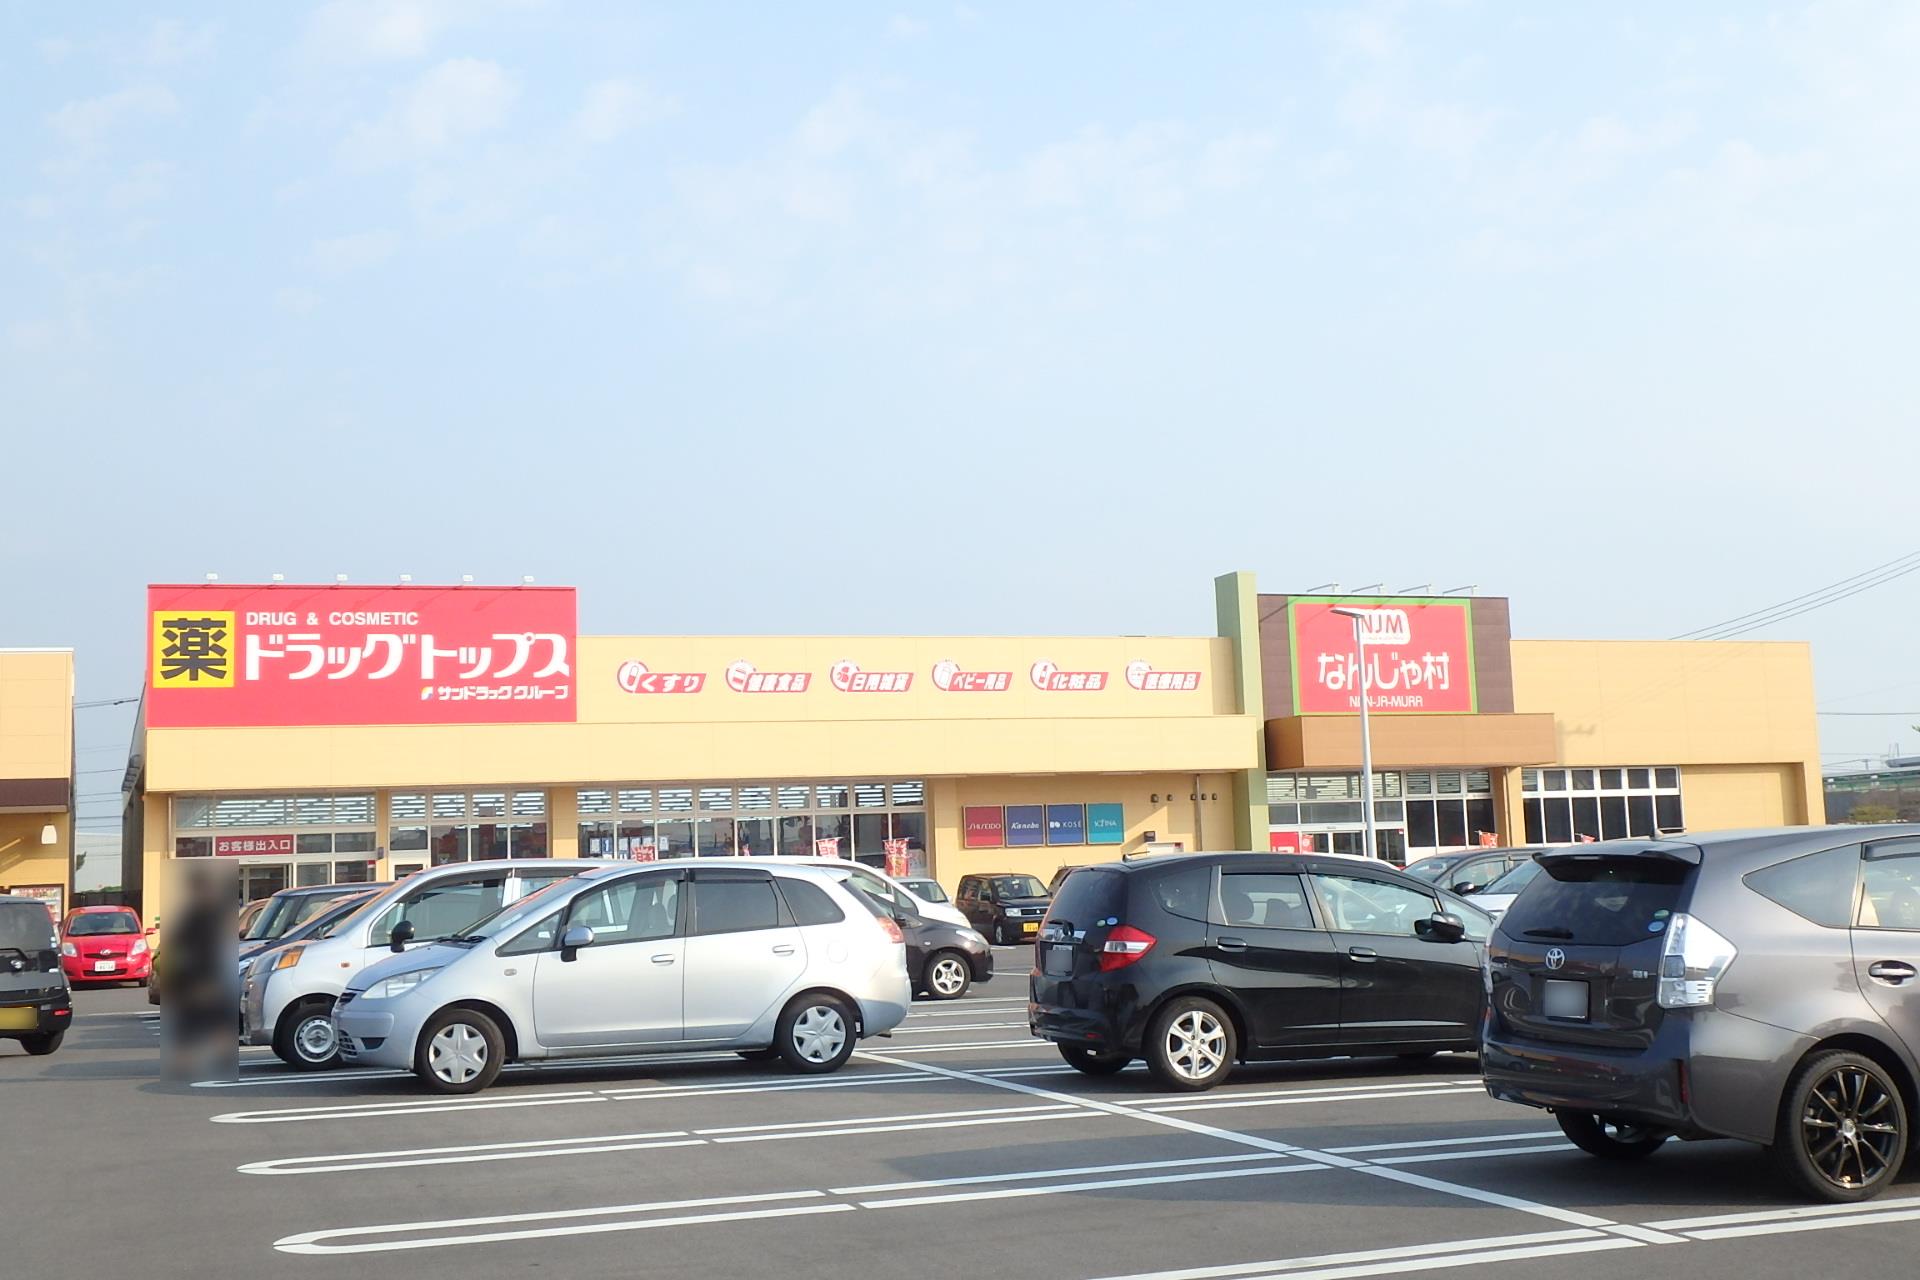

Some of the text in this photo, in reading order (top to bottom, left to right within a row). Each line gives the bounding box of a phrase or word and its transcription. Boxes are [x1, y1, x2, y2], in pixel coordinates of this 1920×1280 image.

[246, 611, 419, 626] DRUG & COSMETIC
[1361, 614, 1404, 634] NJM
[160, 617, 228, 681] 薬
[245, 631, 570, 681] ドラッグトップス
[1317, 651, 1450, 690] なんじゃ村
[640, 674, 701, 692] くすり
[952, 673, 1007, 690] ベビー用品
[1052, 673, 1102, 690] 化粧品
[218, 840, 291, 852] お客様出入口
